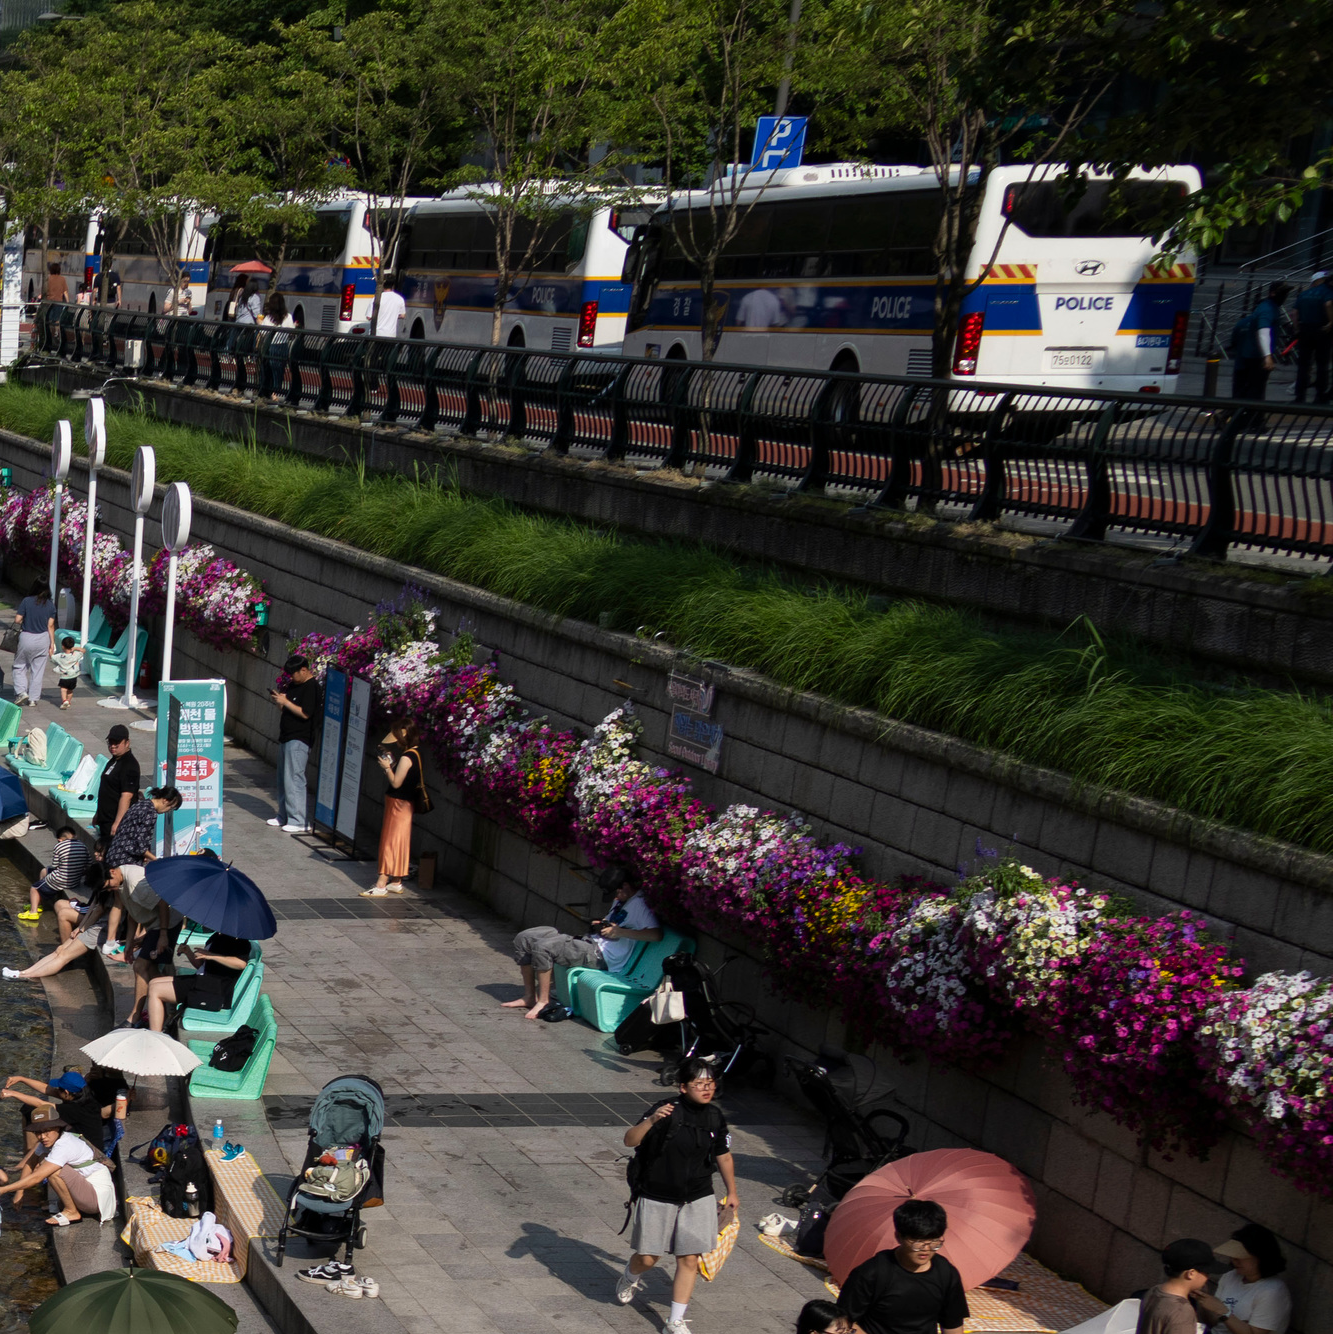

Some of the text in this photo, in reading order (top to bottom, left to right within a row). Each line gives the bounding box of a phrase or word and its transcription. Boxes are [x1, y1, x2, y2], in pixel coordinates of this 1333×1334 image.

[770, 119, 792, 146] P
[531, 287, 555, 304] POLICE
[1055, 297, 1114, 311] POLICE
[673, 297, 692, 316] 경찰
[870, 296, 912, 319] POLICE
[204, 708, 216, 720] 물
[180, 722, 214, 735] 벙첨벙
